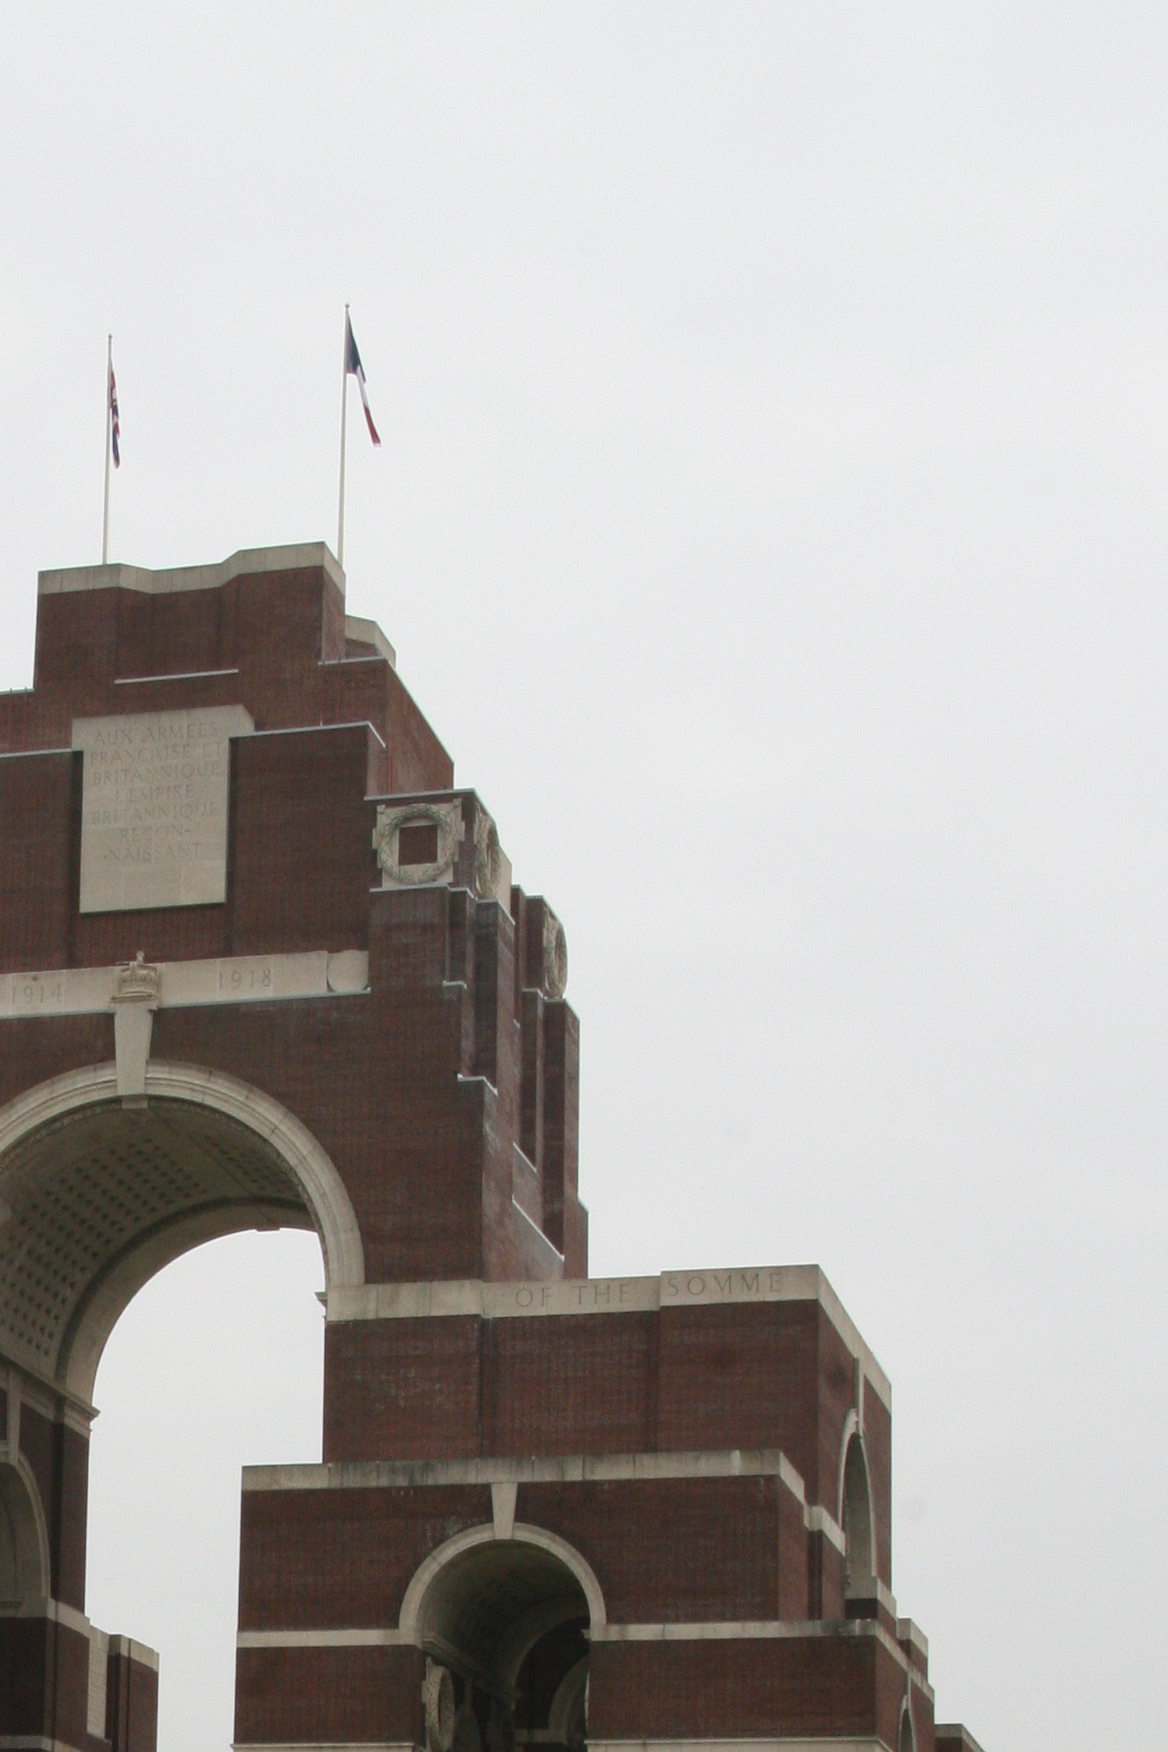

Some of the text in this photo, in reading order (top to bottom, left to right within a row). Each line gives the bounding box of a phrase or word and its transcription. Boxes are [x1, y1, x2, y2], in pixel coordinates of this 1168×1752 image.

[94, 729, 133, 746] AUX
[202, 741, 221, 758] ET
[92, 761, 220, 786] BRITANNIQUE
[92, 801, 219, 826] BRITANNIQUE
[11, 968, 272, 1005] 1914 1918
[515, 1272, 783, 1308] OF THE SOMME
